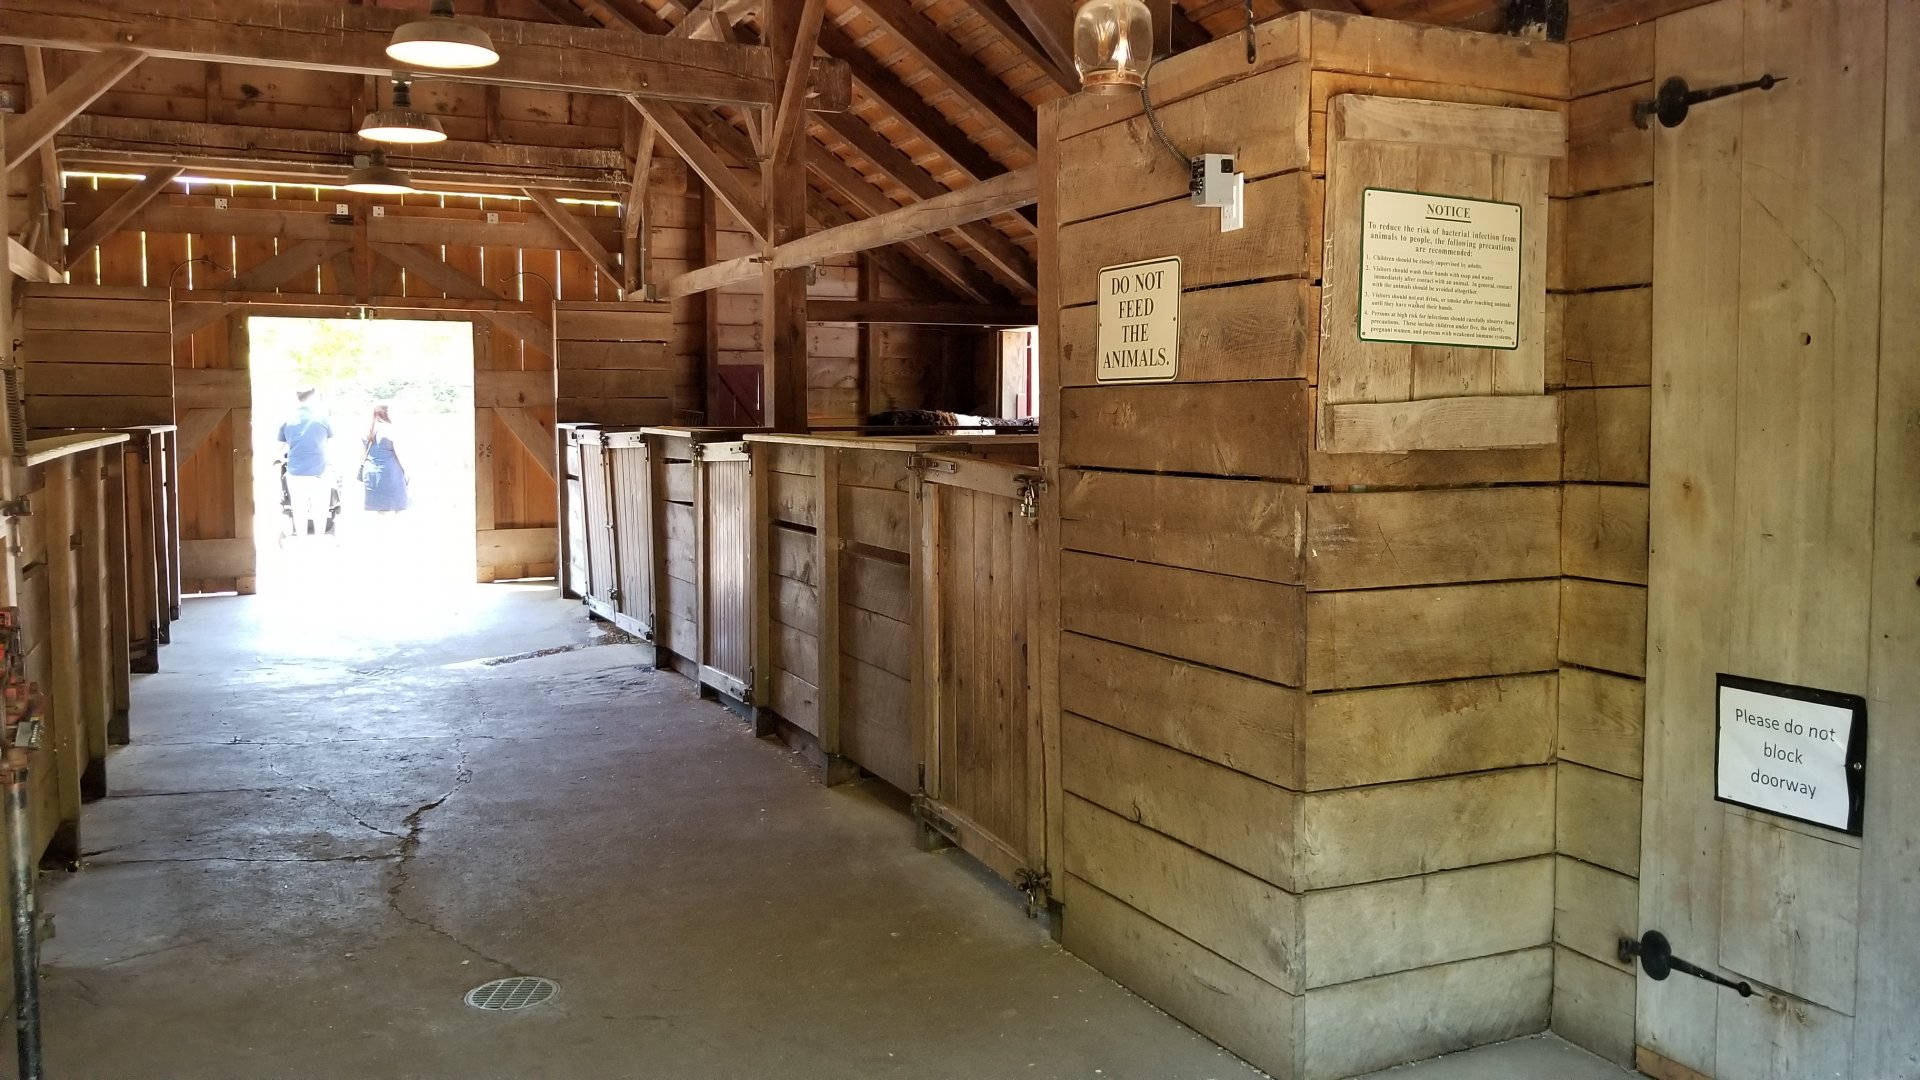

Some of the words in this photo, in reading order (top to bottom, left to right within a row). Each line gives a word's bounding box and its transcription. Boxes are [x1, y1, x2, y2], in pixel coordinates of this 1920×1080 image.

[1427, 203, 1471, 219] NOTICE
[1368, 221, 1377, 229] To
[1380, 222, 1401, 231] reduce
[1418, 226, 1430, 234] risk
[1442, 228, 1470, 238] bacterial
[1473, 232, 1500, 241] infection
[1502, 234, 1517, 243] from
[1371, 232, 1397, 241] animals
[1410, 236, 1432, 244] people,
[1435, 237, 1445, 245] the
[1448, 238, 1476, 249] following
[1479, 243, 1514, 252] precautions
[1429, 247, 1473, 257] recommended:
[1111, 276, 1130, 296] DO
[1135, 270, 1165, 293] NOT
[1118, 298, 1154, 319] FEED
[1122, 323, 1149, 343] THE
[1103, 347, 1170, 369] ANIMALS.
[1735, 708, 1780, 731] Please
[1784, 718, 1803, 736] do
[1808, 725, 1836, 742] not
[1763, 741, 1803, 765] block
[1750, 768, 1817, 800] doorway
